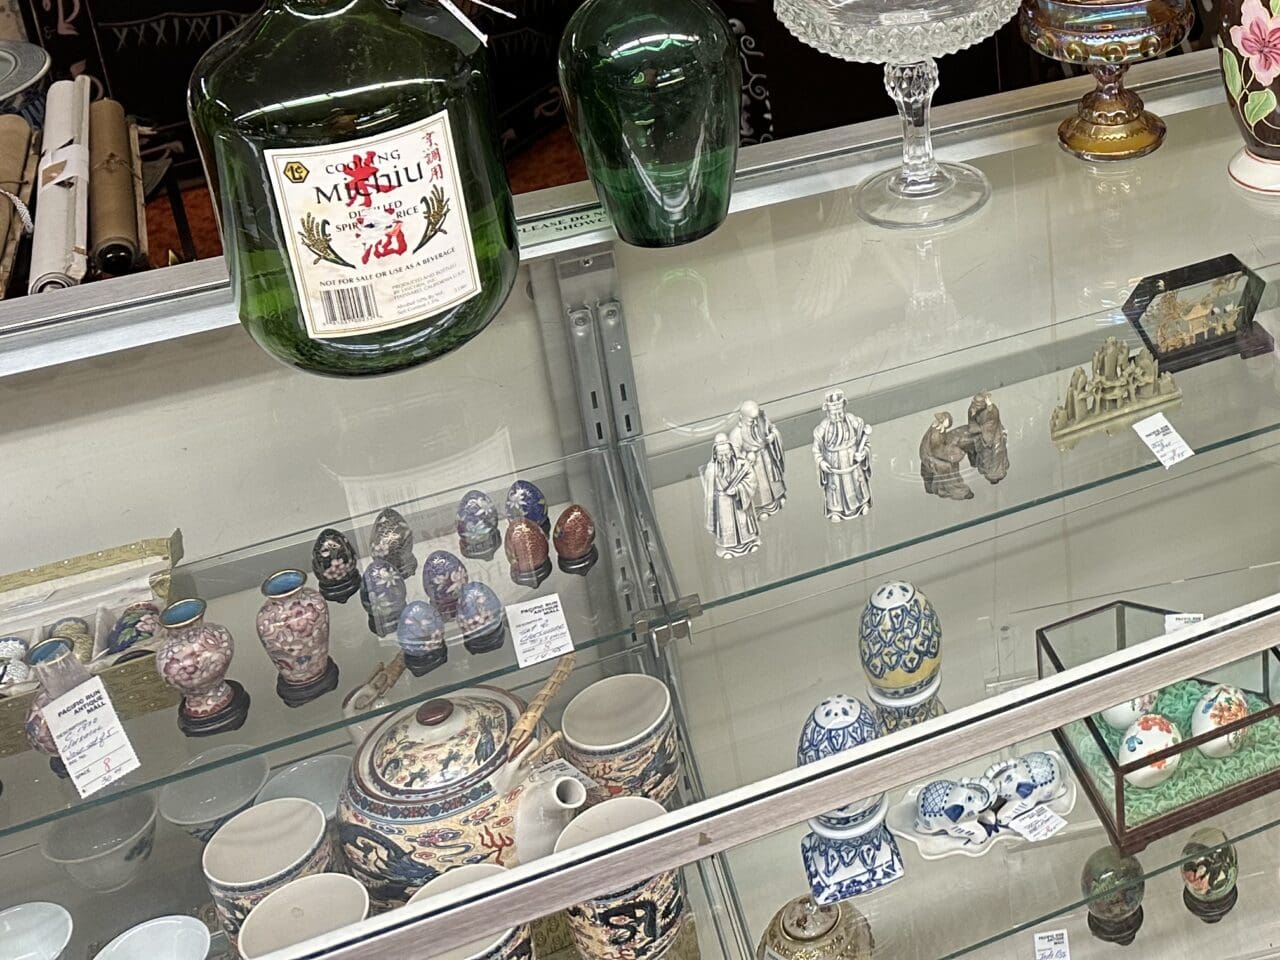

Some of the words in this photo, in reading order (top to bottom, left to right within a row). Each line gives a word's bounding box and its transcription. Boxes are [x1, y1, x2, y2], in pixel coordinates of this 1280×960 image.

[396, 205, 420, 219] RICE
[570, 214, 590, 222] DO
[319, 279, 336, 287] NOT
[338, 277, 355, 286] FOR
[356, 274, 374, 283] SALE
[375, 270, 388, 279] OR
[389, 267, 404, 276] USE
[405, 263, 415, 271] AS
[414, 260, 422, 268] A
[422, 246, 456, 265] BEVERAGE
[57, 697, 85, 717] PACIFIC
[85, 689, 101, 701] RUN
[73, 695, 104, 715] ANTIQUE
[86, 701, 106, 714] MALL
